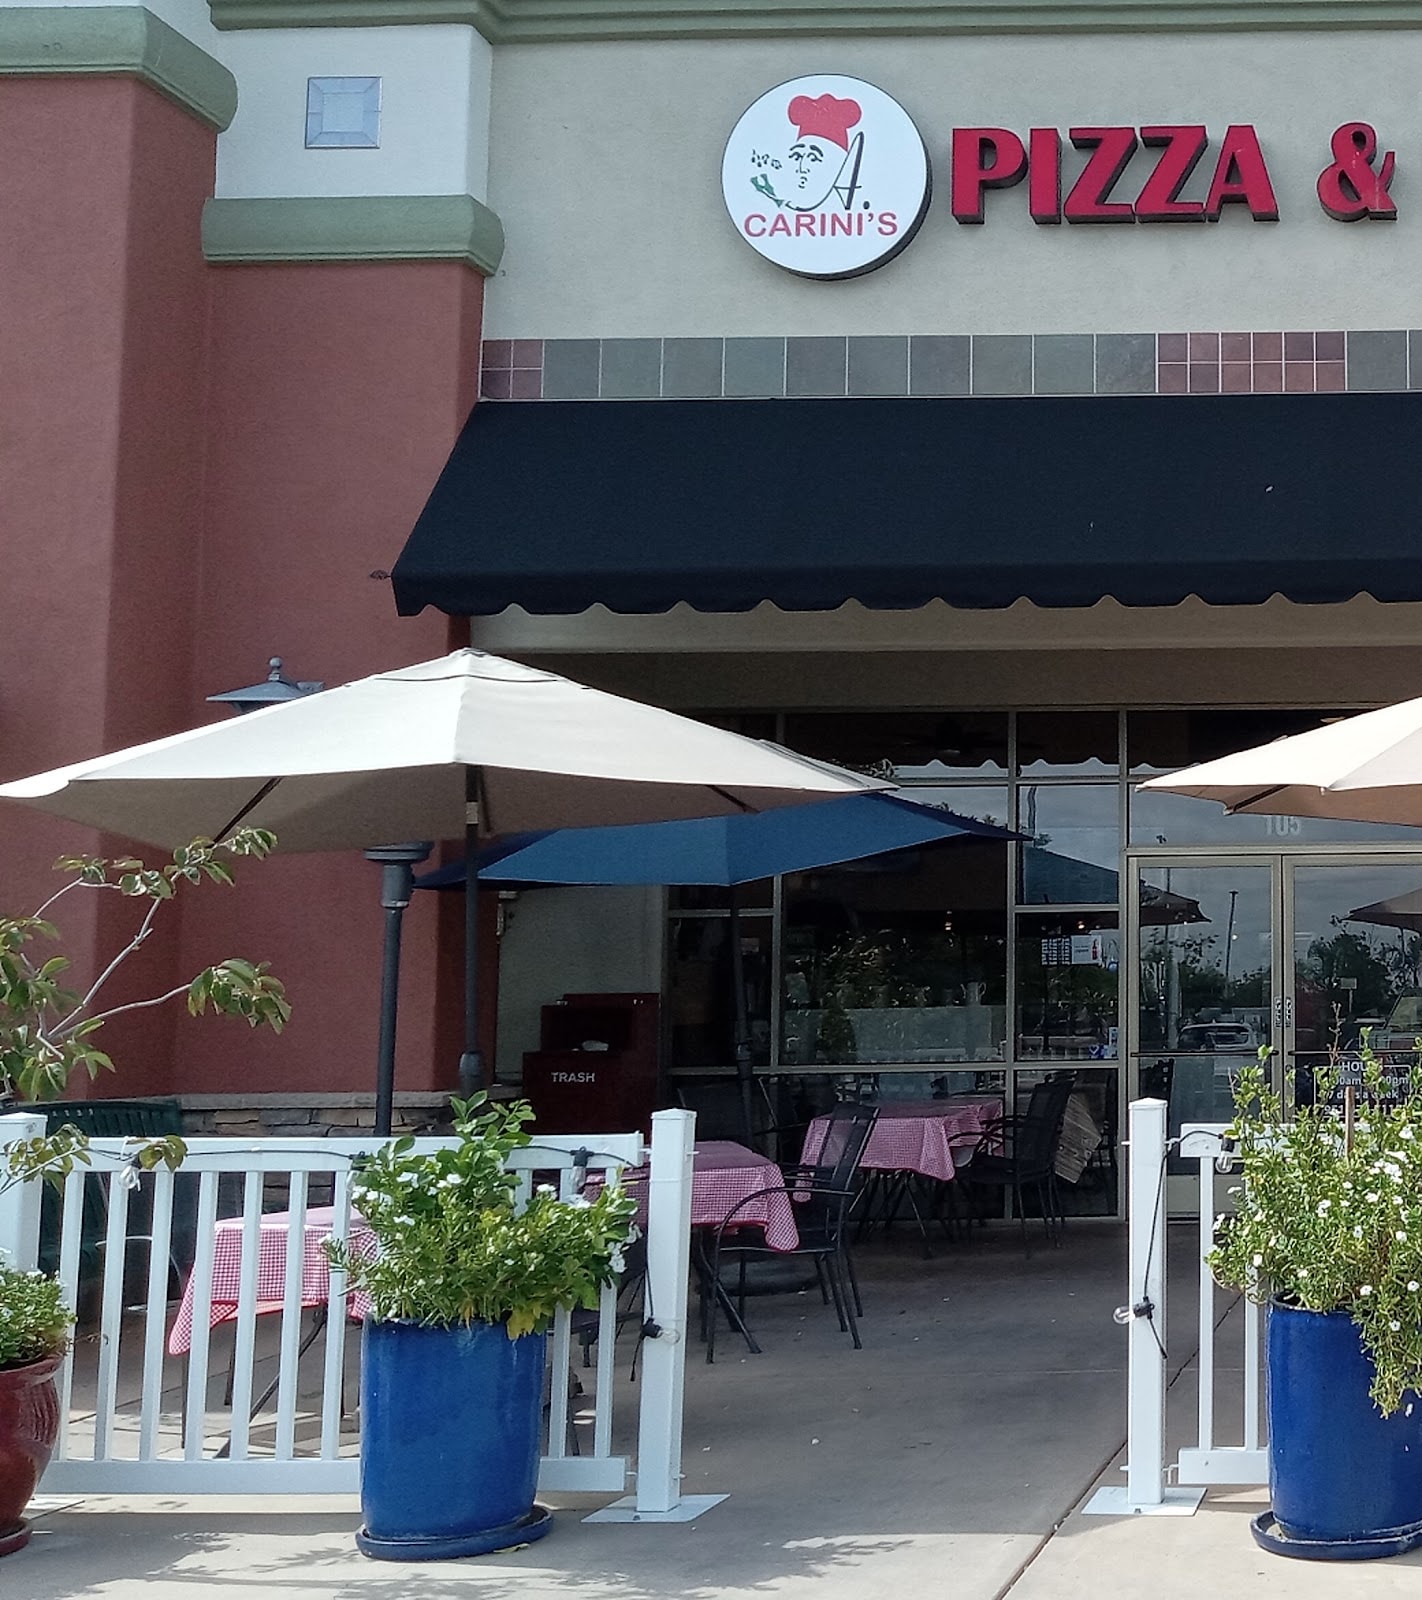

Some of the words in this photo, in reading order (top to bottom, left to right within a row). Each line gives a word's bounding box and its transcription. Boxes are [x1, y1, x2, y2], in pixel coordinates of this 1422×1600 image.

[952, 125, 1280, 225] PIZZA
[1316, 121, 1398, 221] &
[744, 211, 898, 238] CARINI'S
[1341, 1060, 1383, 1072] HOU
[551, 1072, 596, 1083] TRASH
[1336, 1089, 1360, 1100] ds
